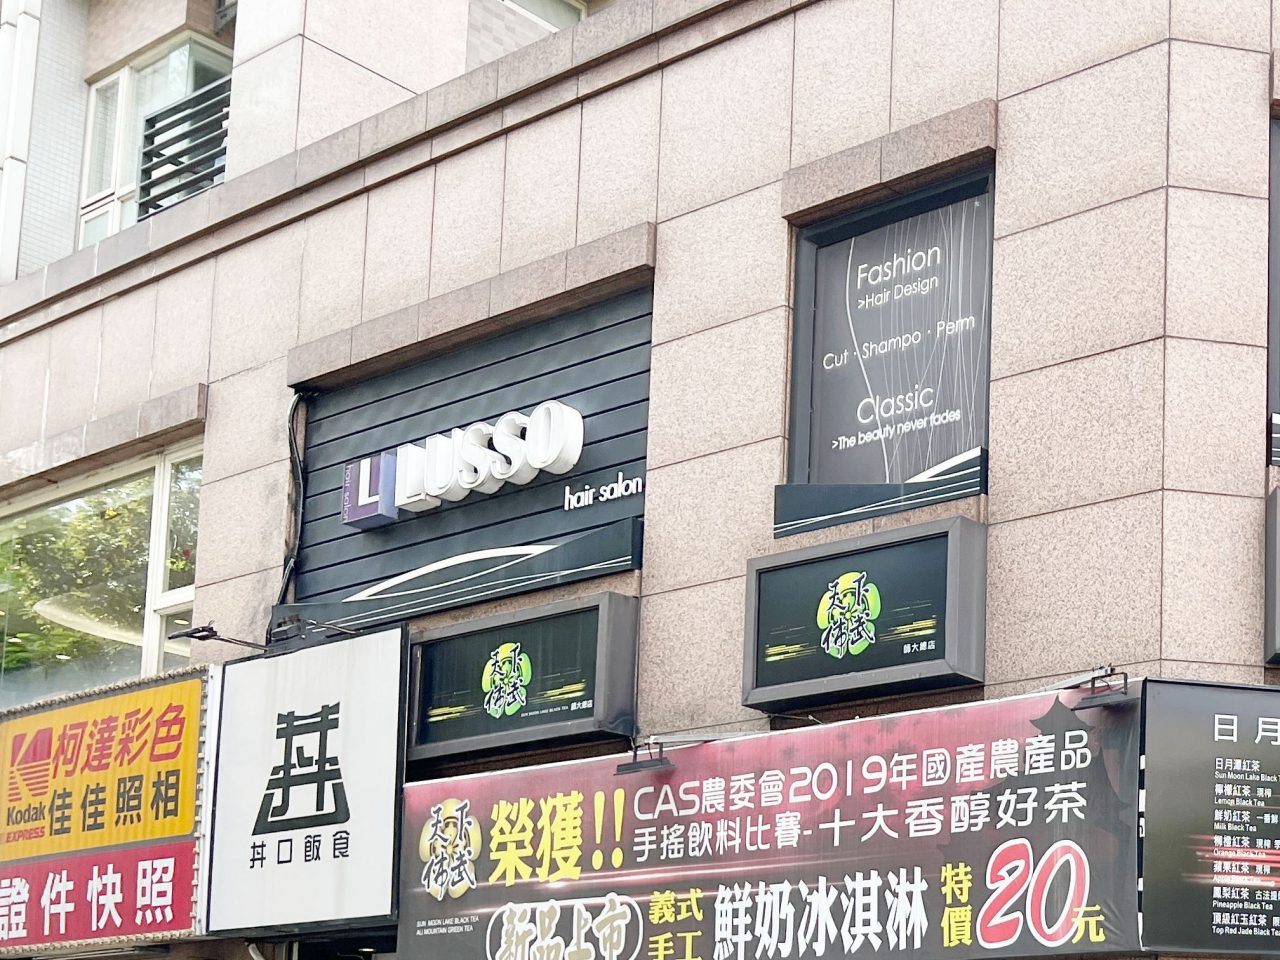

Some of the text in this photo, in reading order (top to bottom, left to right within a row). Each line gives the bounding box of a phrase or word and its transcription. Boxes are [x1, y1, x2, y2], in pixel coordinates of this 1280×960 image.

[857, 245, 941, 290] Fashion
[894, 275, 939, 300] Design
[823, 315, 975, 370] Cut Shampo Perm
[857, 384, 934, 424] Classic
[858, 424, 896, 445] beauty
[897, 416, 930, 435] never
[929, 407, 961, 427] fades
[395, 400, 584, 513] LUSSO
[564, 471, 643, 512] hair salon
[52, 702, 187, 780] 柯達彩色
[633, 729, 1093, 821] CAS農委會2019年國產農產品
[1214, 771, 1227, 779] Sun
[1227, 771, 1245, 780] Moon
[1245, 773, 1260, 781] Lake
[1260, 773, 1278, 782] Black
[1215, 757, 1261, 772] 日月潭紅茶
[6, 801, 46, 826] Kodak
[48, 769, 181, 837] 佳佳照相
[632, 781, 1088, 863] 手搖飲料比賽-十大香醇好茶
[6, 826, 46, 843] EXPRESS
[250, 830, 351, 870] 丼口飯食
[488, 788, 626, 888] 榮獲!!
[0, 857, 175, 941] 證件快照
[649, 889, 704, 925] 義式
[940, 862, 974, 948] 特價
[1212, 900, 1274, 911] Pineapple Black Tea
[1212, 926, 1225, 935] Top
[1225, 926, 1238, 934] Red
[1238, 927, 1253, 935] Jade
[1253, 928, 1271, 936] Black
